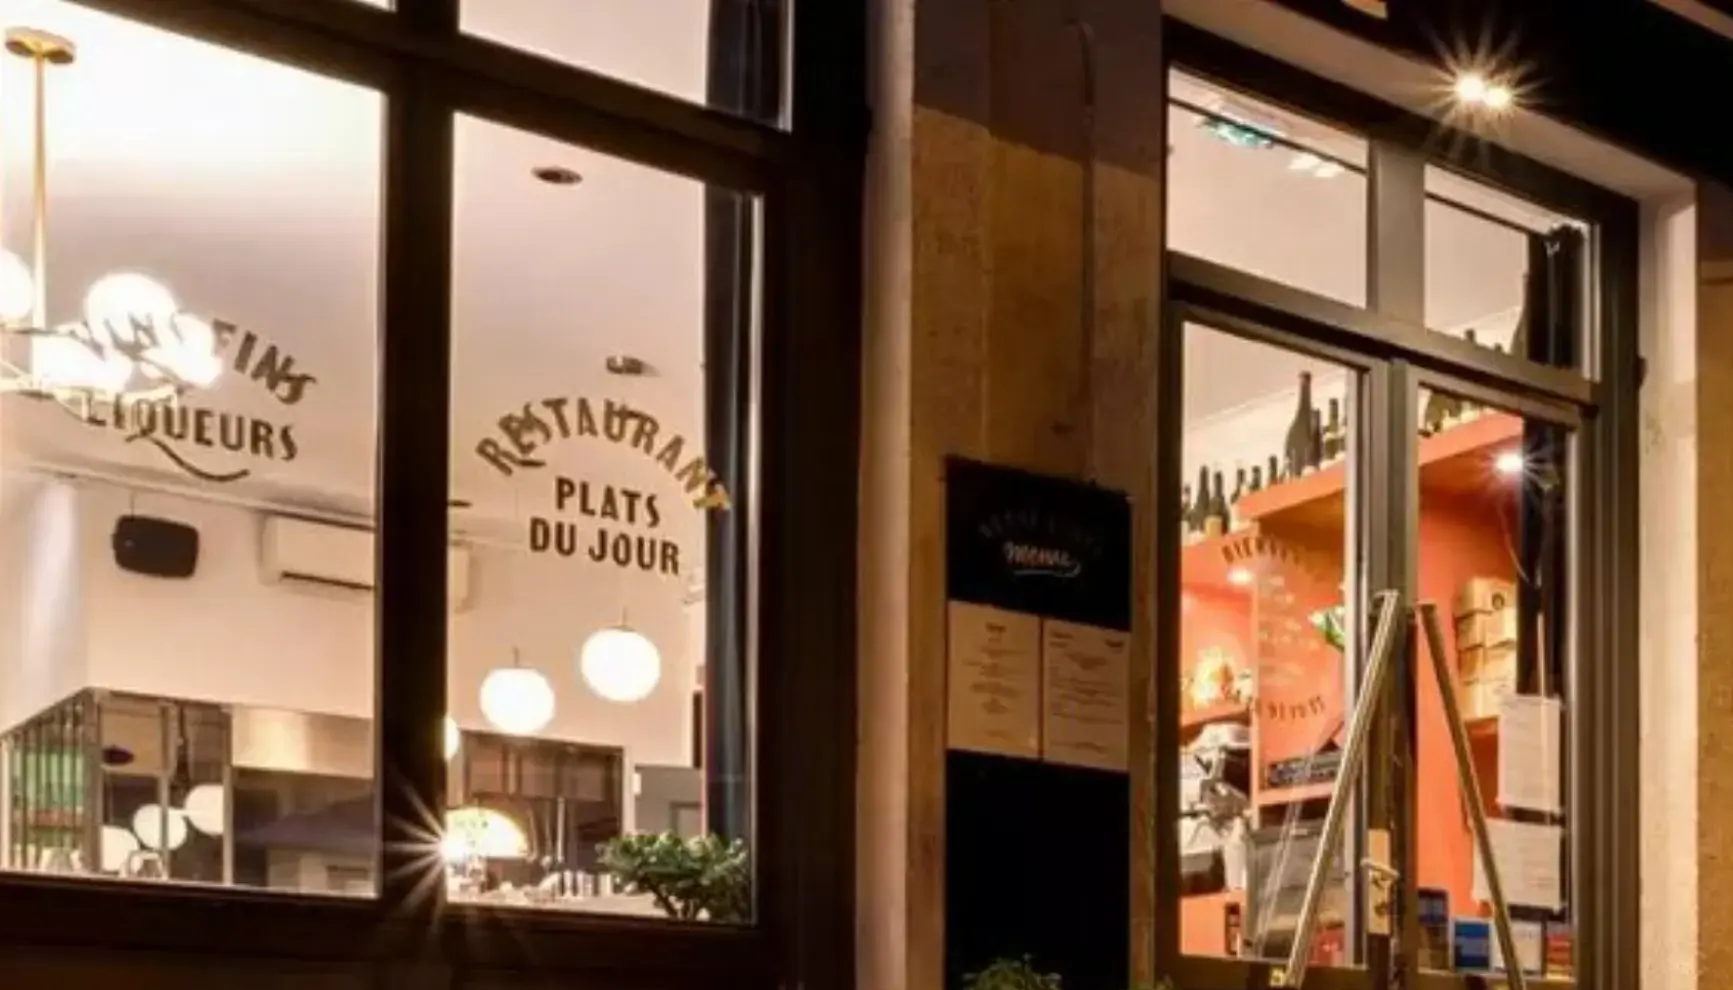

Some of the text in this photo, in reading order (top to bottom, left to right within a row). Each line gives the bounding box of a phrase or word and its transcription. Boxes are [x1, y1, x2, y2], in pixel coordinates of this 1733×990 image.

[212, 317, 318, 405] FINS
[84, 392, 298, 481] LIQUEURS
[554, 476, 661, 529] PLATS
[529, 516, 680, 576] DU JOUR
